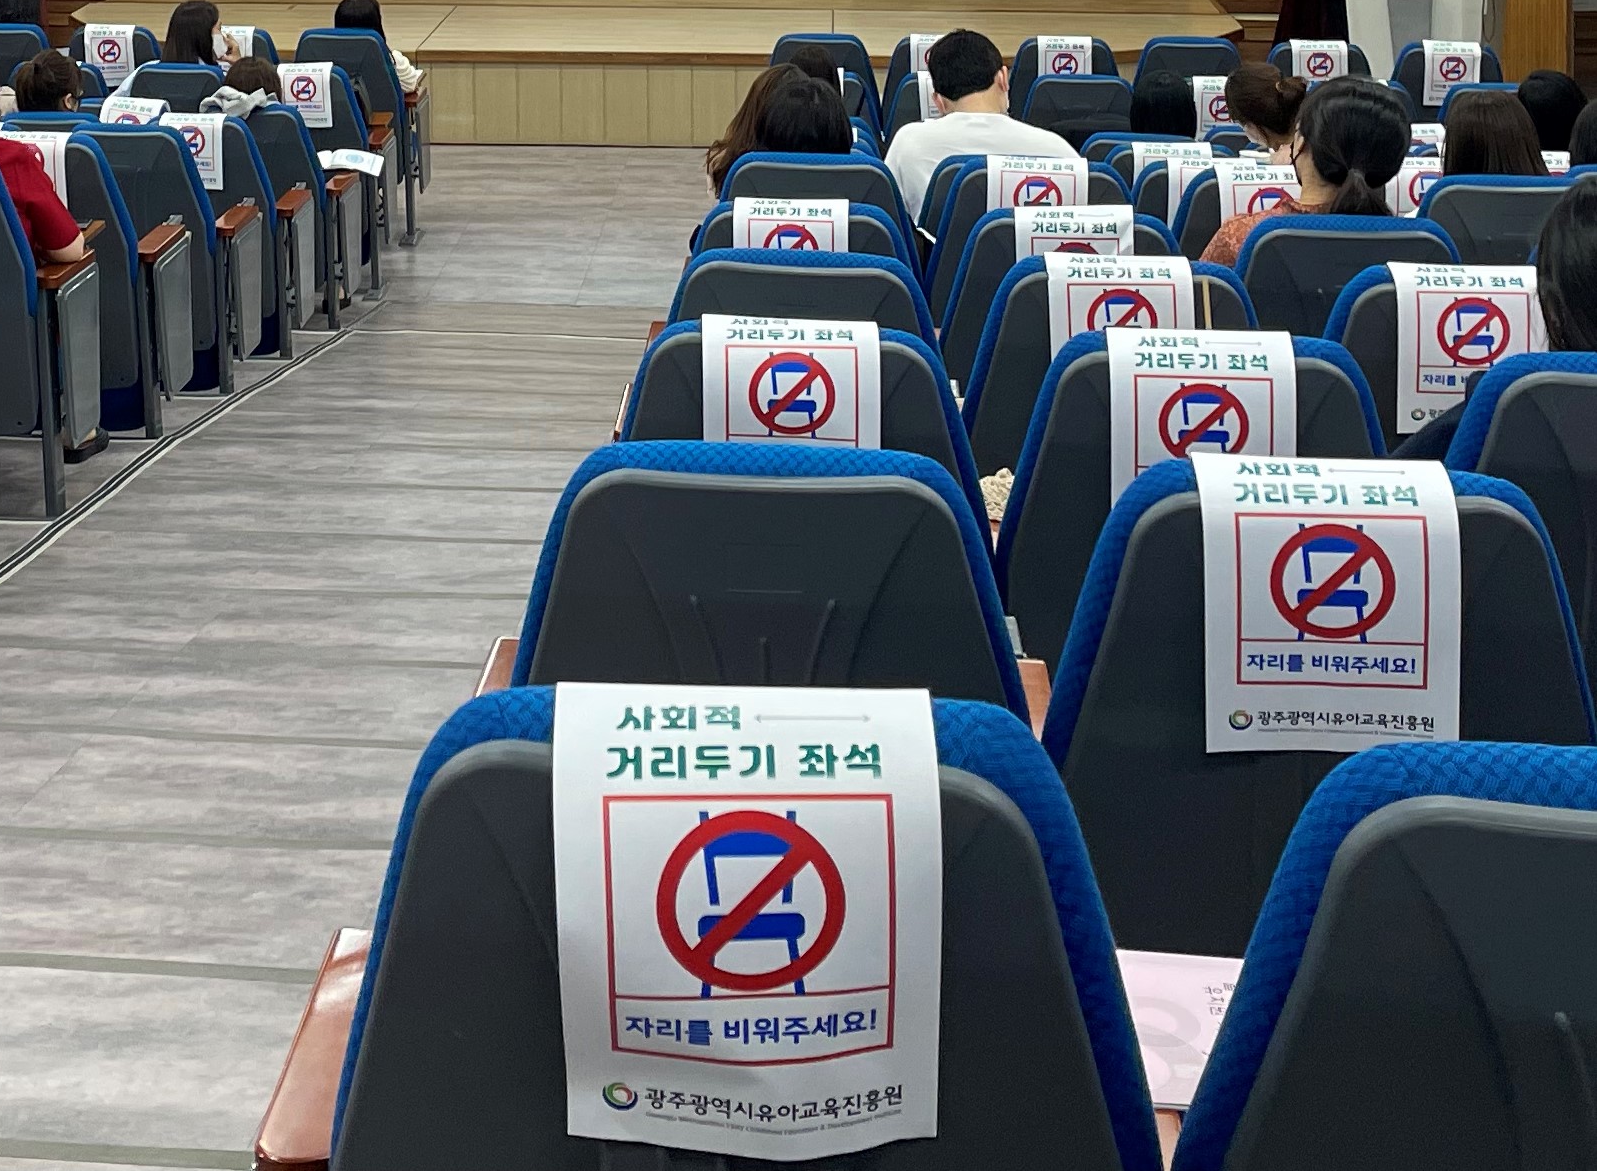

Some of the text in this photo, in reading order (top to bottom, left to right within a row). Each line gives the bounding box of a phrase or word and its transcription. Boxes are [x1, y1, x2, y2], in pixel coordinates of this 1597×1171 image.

[1031, 221, 1118, 235] 거리두기 좌석
[1067, 267, 1172, 279] 거리두기 좌석
[1414, 275, 1524, 288] 거리두기 좌석
[726, 329, 853, 341] 거리두기 좌석
[1138, 336, 1199, 348] 사회적
[1134, 352, 1268, 371] 거리두기 좌석
[1236, 462, 1321, 477] 사회적
[1233, 483, 1419, 507] 거리두기 좌석
[1247, 654, 1416, 674] 자리를 비워주세요!
[617, 705, 741, 731] 사회적
[1257, 711, 1434, 732] 광주광역시유아교육진흥원
[607, 744, 882, 780] 거리두기 좌석
[625, 1010, 877, 1046] 자리를 비워주세요!
[645, 1084, 902, 1122] 광주광역시유아교육진흥원
